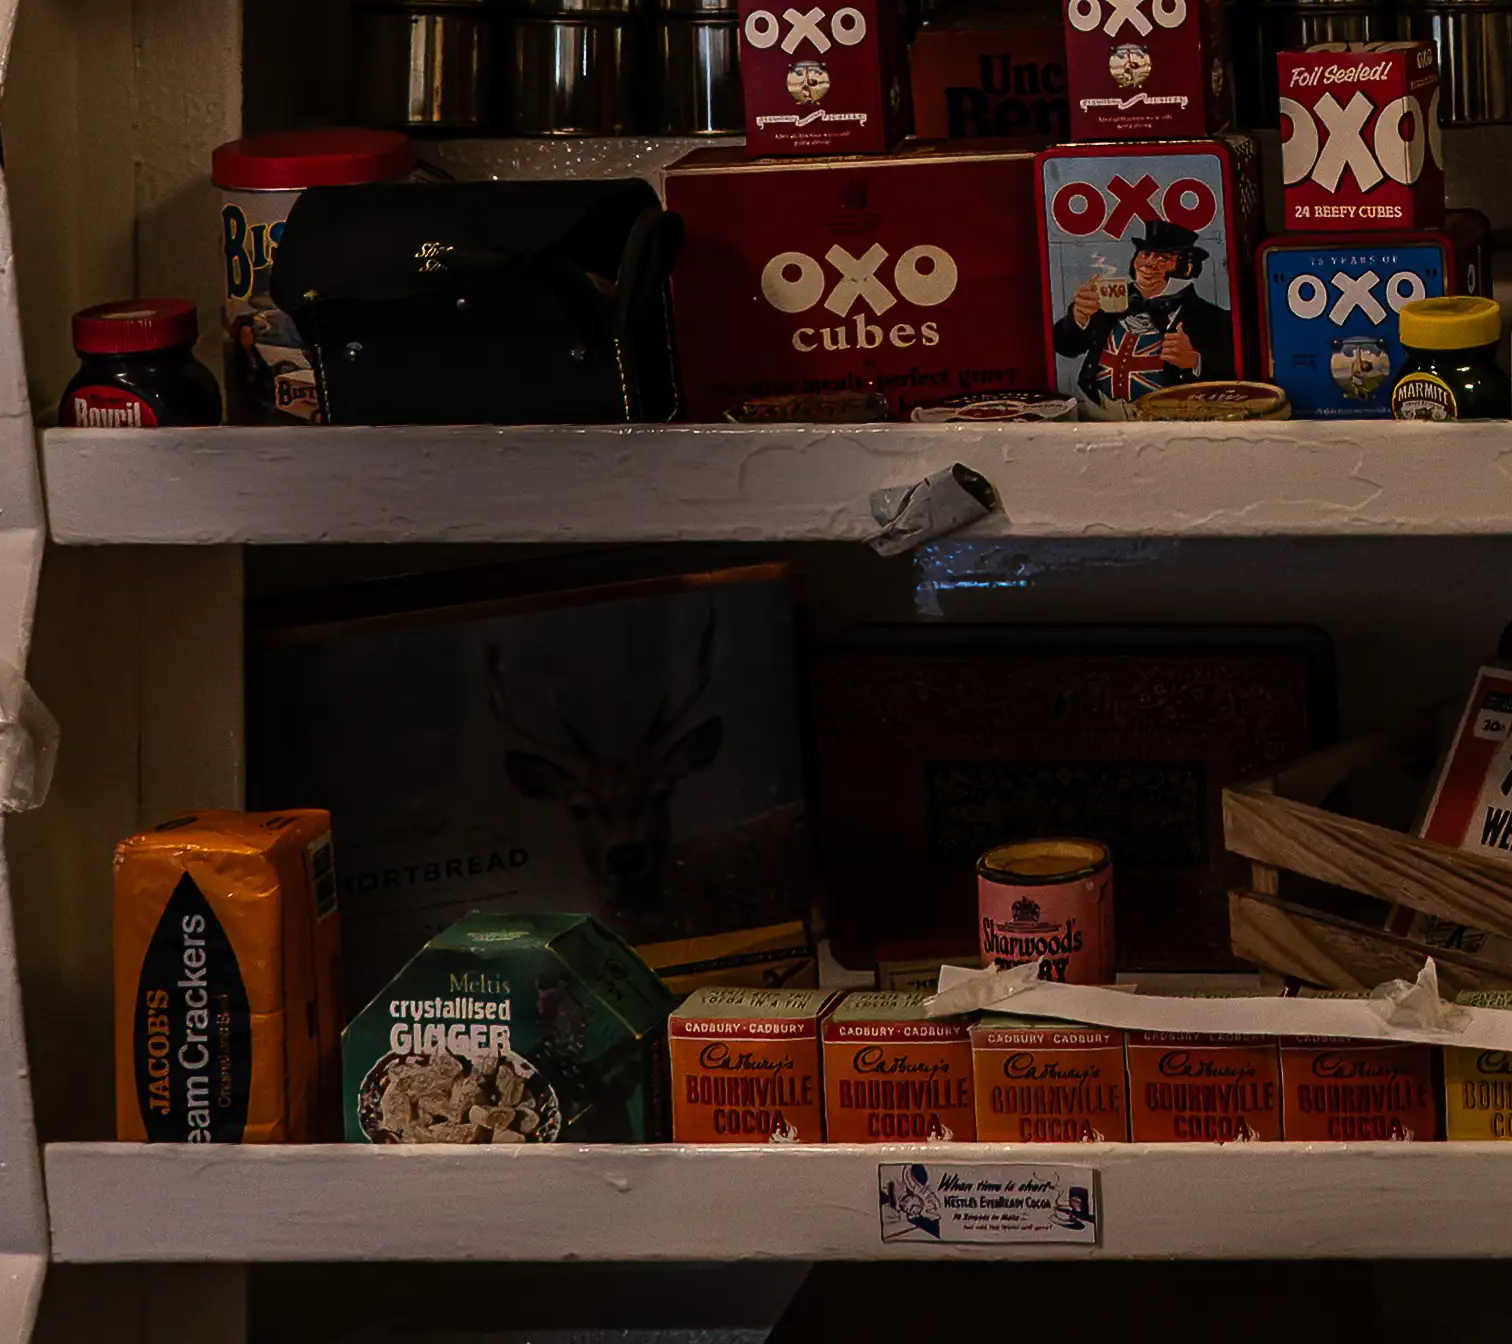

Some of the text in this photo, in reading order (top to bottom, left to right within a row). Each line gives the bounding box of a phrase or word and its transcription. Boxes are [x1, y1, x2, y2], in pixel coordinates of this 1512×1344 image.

[744, 6, 867, 55] OXO
[1289, 60, 1393, 88] Foil Sealed!
[760, 243, 959, 317] OXO
[791, 312, 941, 354] cubes
[388, 998, 512, 1024] crystallised
[144, 987, 170, 1117] JACOB'S
[686, 1073, 815, 1108] BOURNVILLE
[713, 1107, 788, 1137] COCOA
